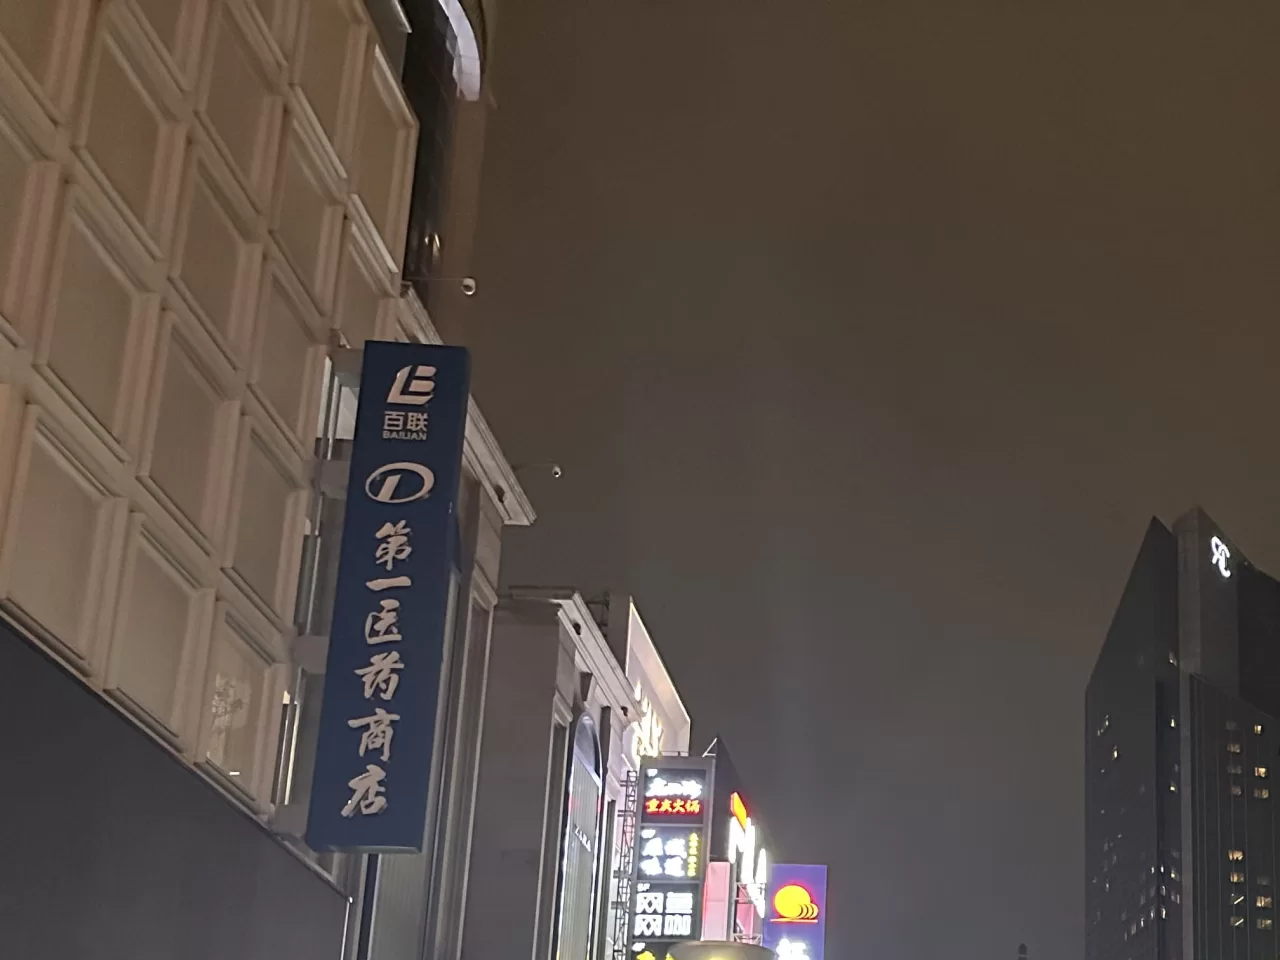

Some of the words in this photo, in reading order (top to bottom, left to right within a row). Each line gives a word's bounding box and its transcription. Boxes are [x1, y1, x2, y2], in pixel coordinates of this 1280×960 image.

[384, 411, 428, 431] 百联
[382, 431, 427, 440] BAILIAN
[341, 519, 412, 819] 第一医药商店
